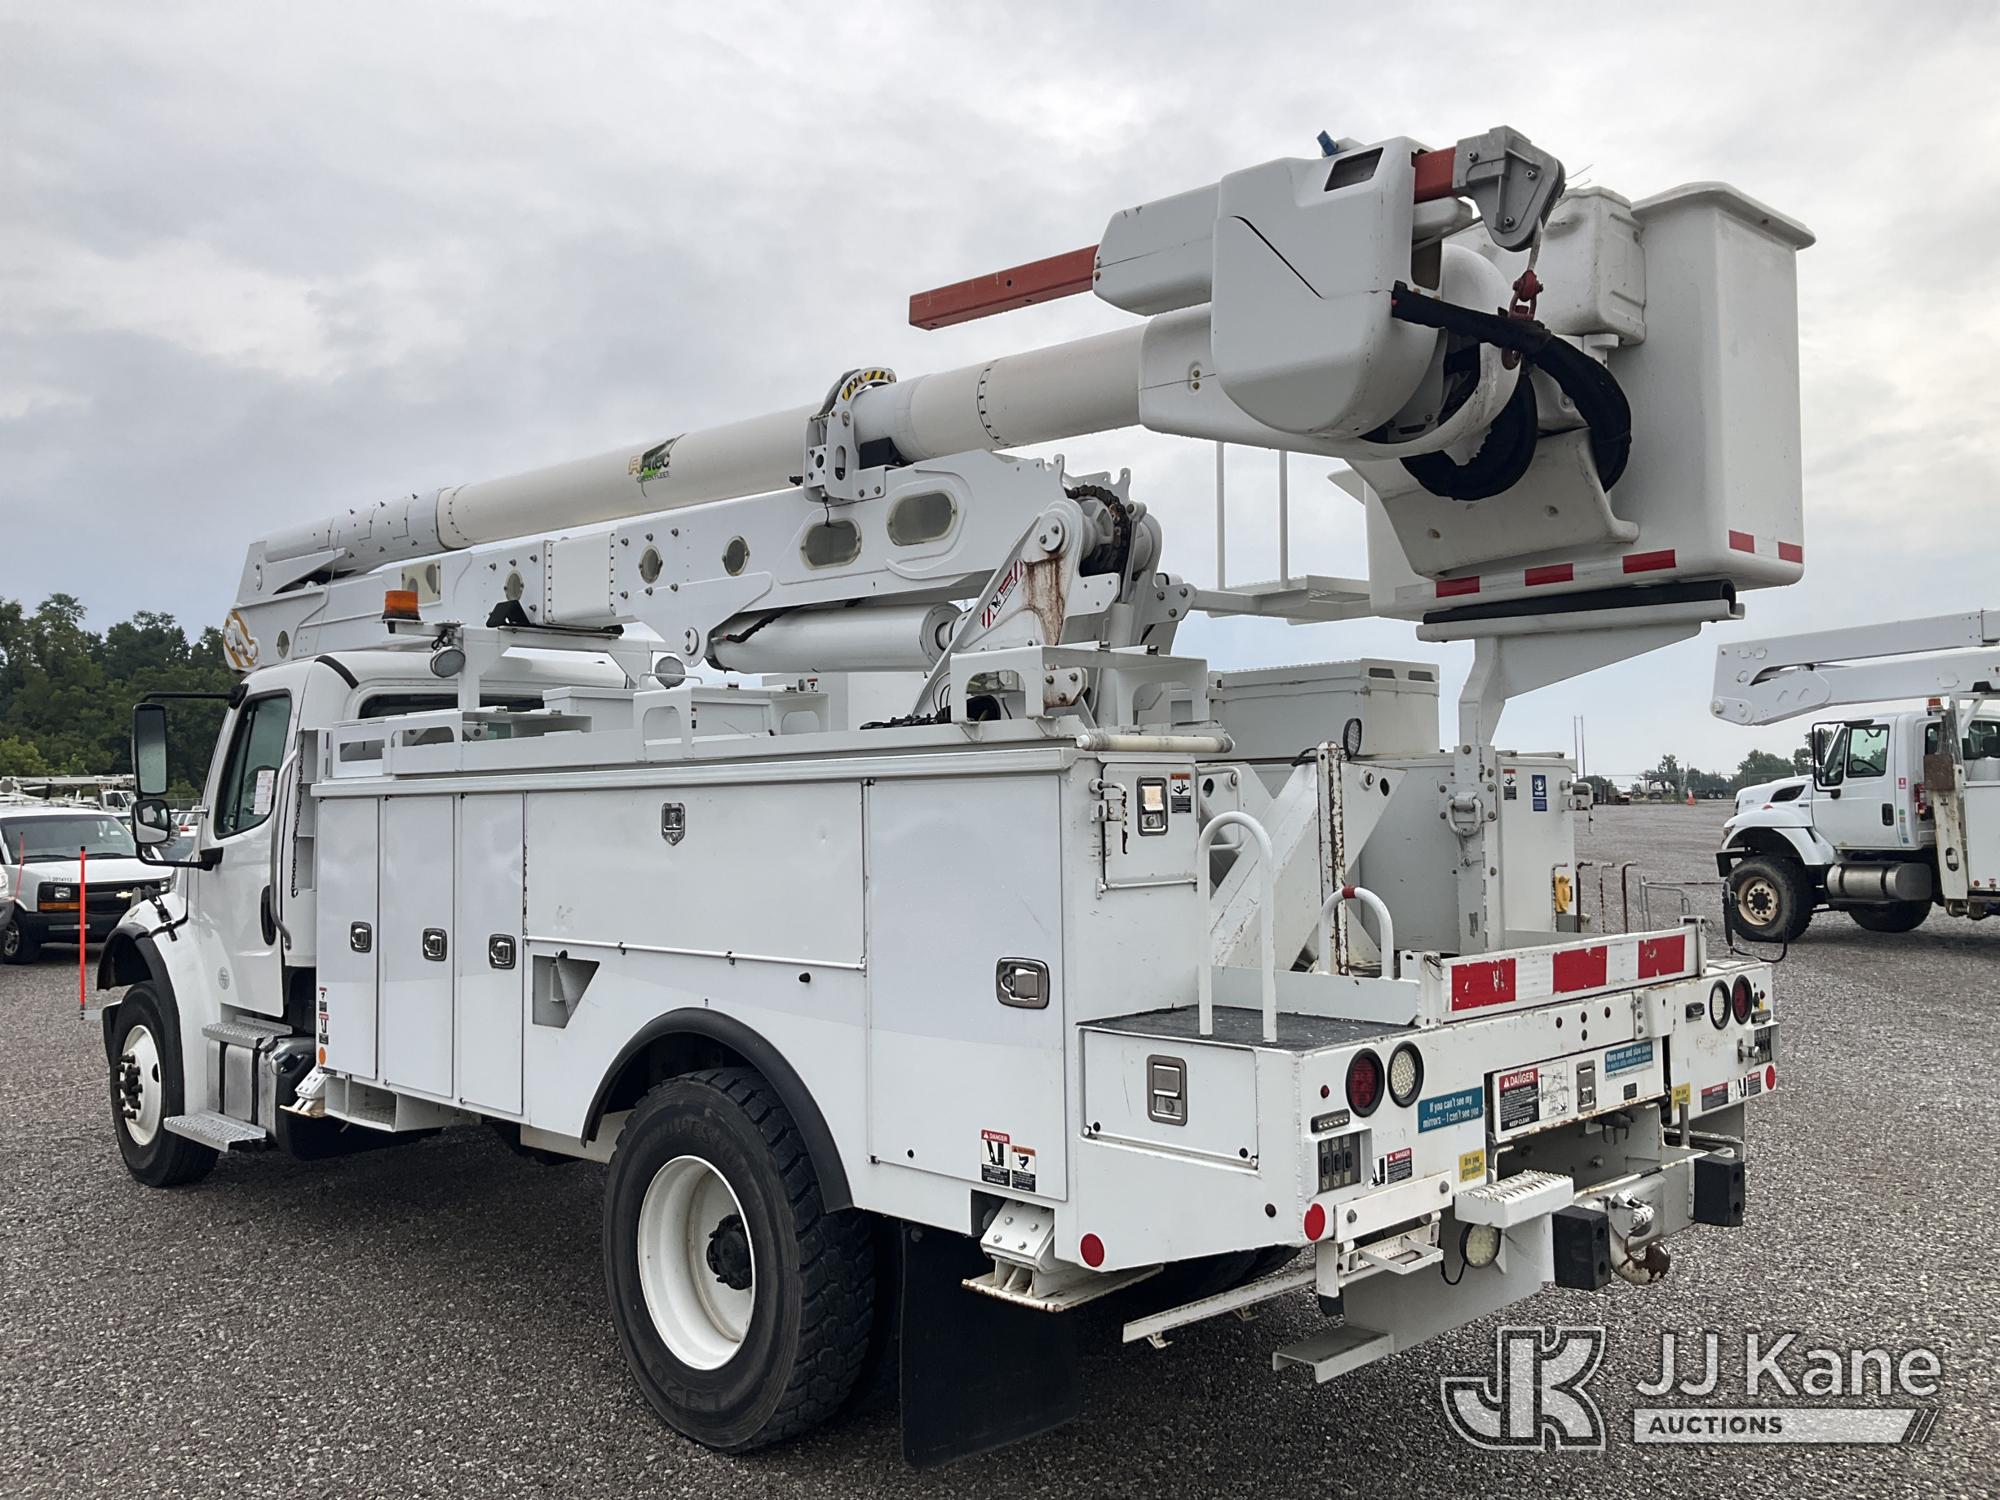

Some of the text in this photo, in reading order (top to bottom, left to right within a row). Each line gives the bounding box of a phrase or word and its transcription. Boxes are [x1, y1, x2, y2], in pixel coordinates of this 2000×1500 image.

[1509, 1072, 1534, 1085] DANGER
[1434, 1102, 1443, 1114] you
[1456, 1096, 1465, 1107] see
